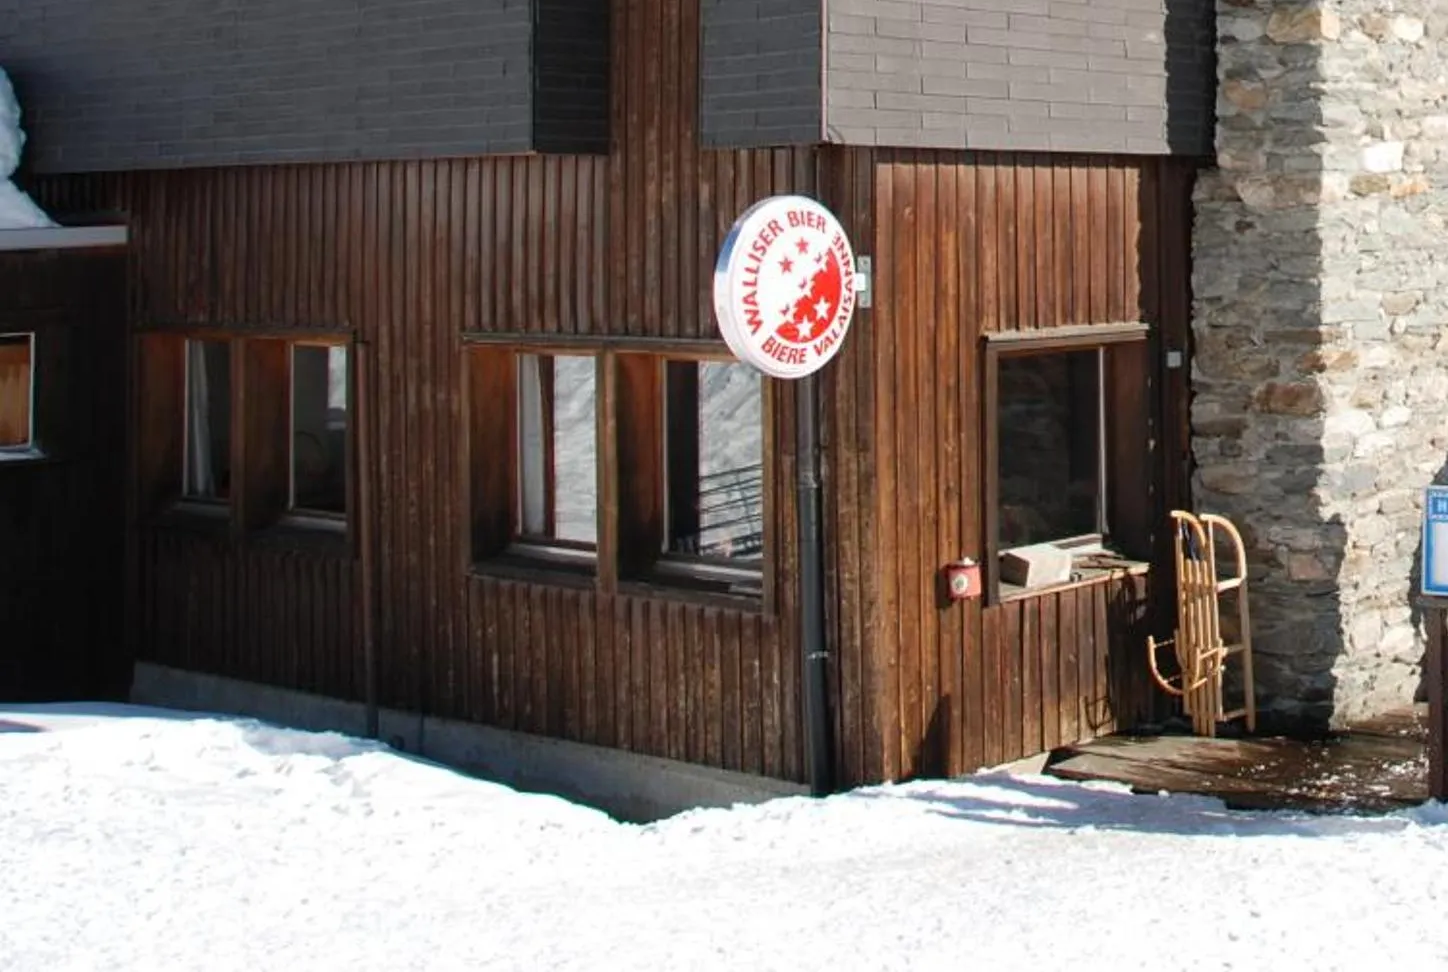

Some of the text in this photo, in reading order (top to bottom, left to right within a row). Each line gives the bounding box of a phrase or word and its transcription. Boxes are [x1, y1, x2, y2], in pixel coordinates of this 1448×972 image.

[742, 210, 827, 335] WALLISER BIER
[761, 231, 853, 364] BIERE VALAISANNE
